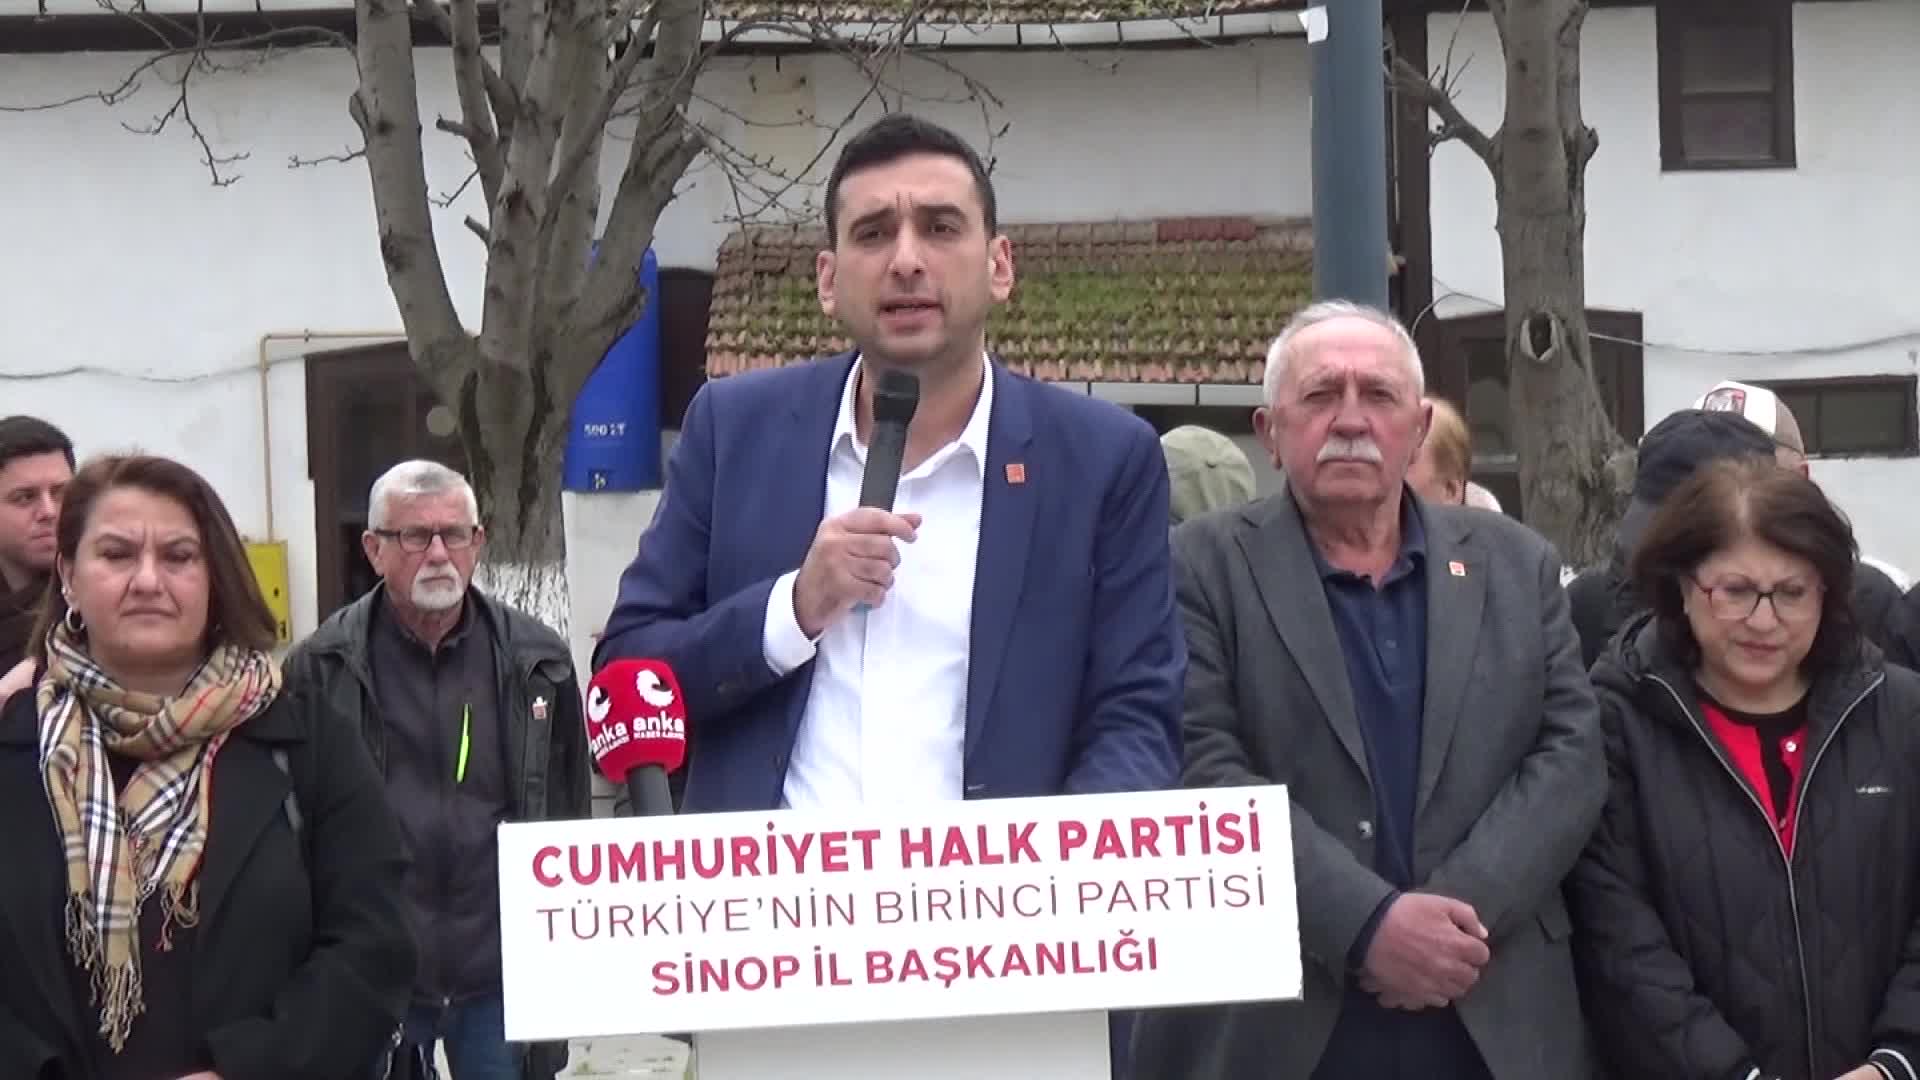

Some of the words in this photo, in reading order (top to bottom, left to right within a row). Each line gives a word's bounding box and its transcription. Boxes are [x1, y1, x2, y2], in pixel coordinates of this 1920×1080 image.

[591, 722, 628, 754] anka
[633, 710, 685, 732] anka
[531, 820, 881, 888] CUMHURİYET
[899, 821, 1041, 869] HALK
[1058, 798, 1261, 862] PARTİSİ
[875, 875, 1057, 924] BİRİNCİ
[1077, 866, 1265, 914] PARTİSİ
[651, 952, 801, 996] SİNOP
[813, 945, 853, 987] İL
[865, 928, 1157, 989] BAŞKANLIĞI
